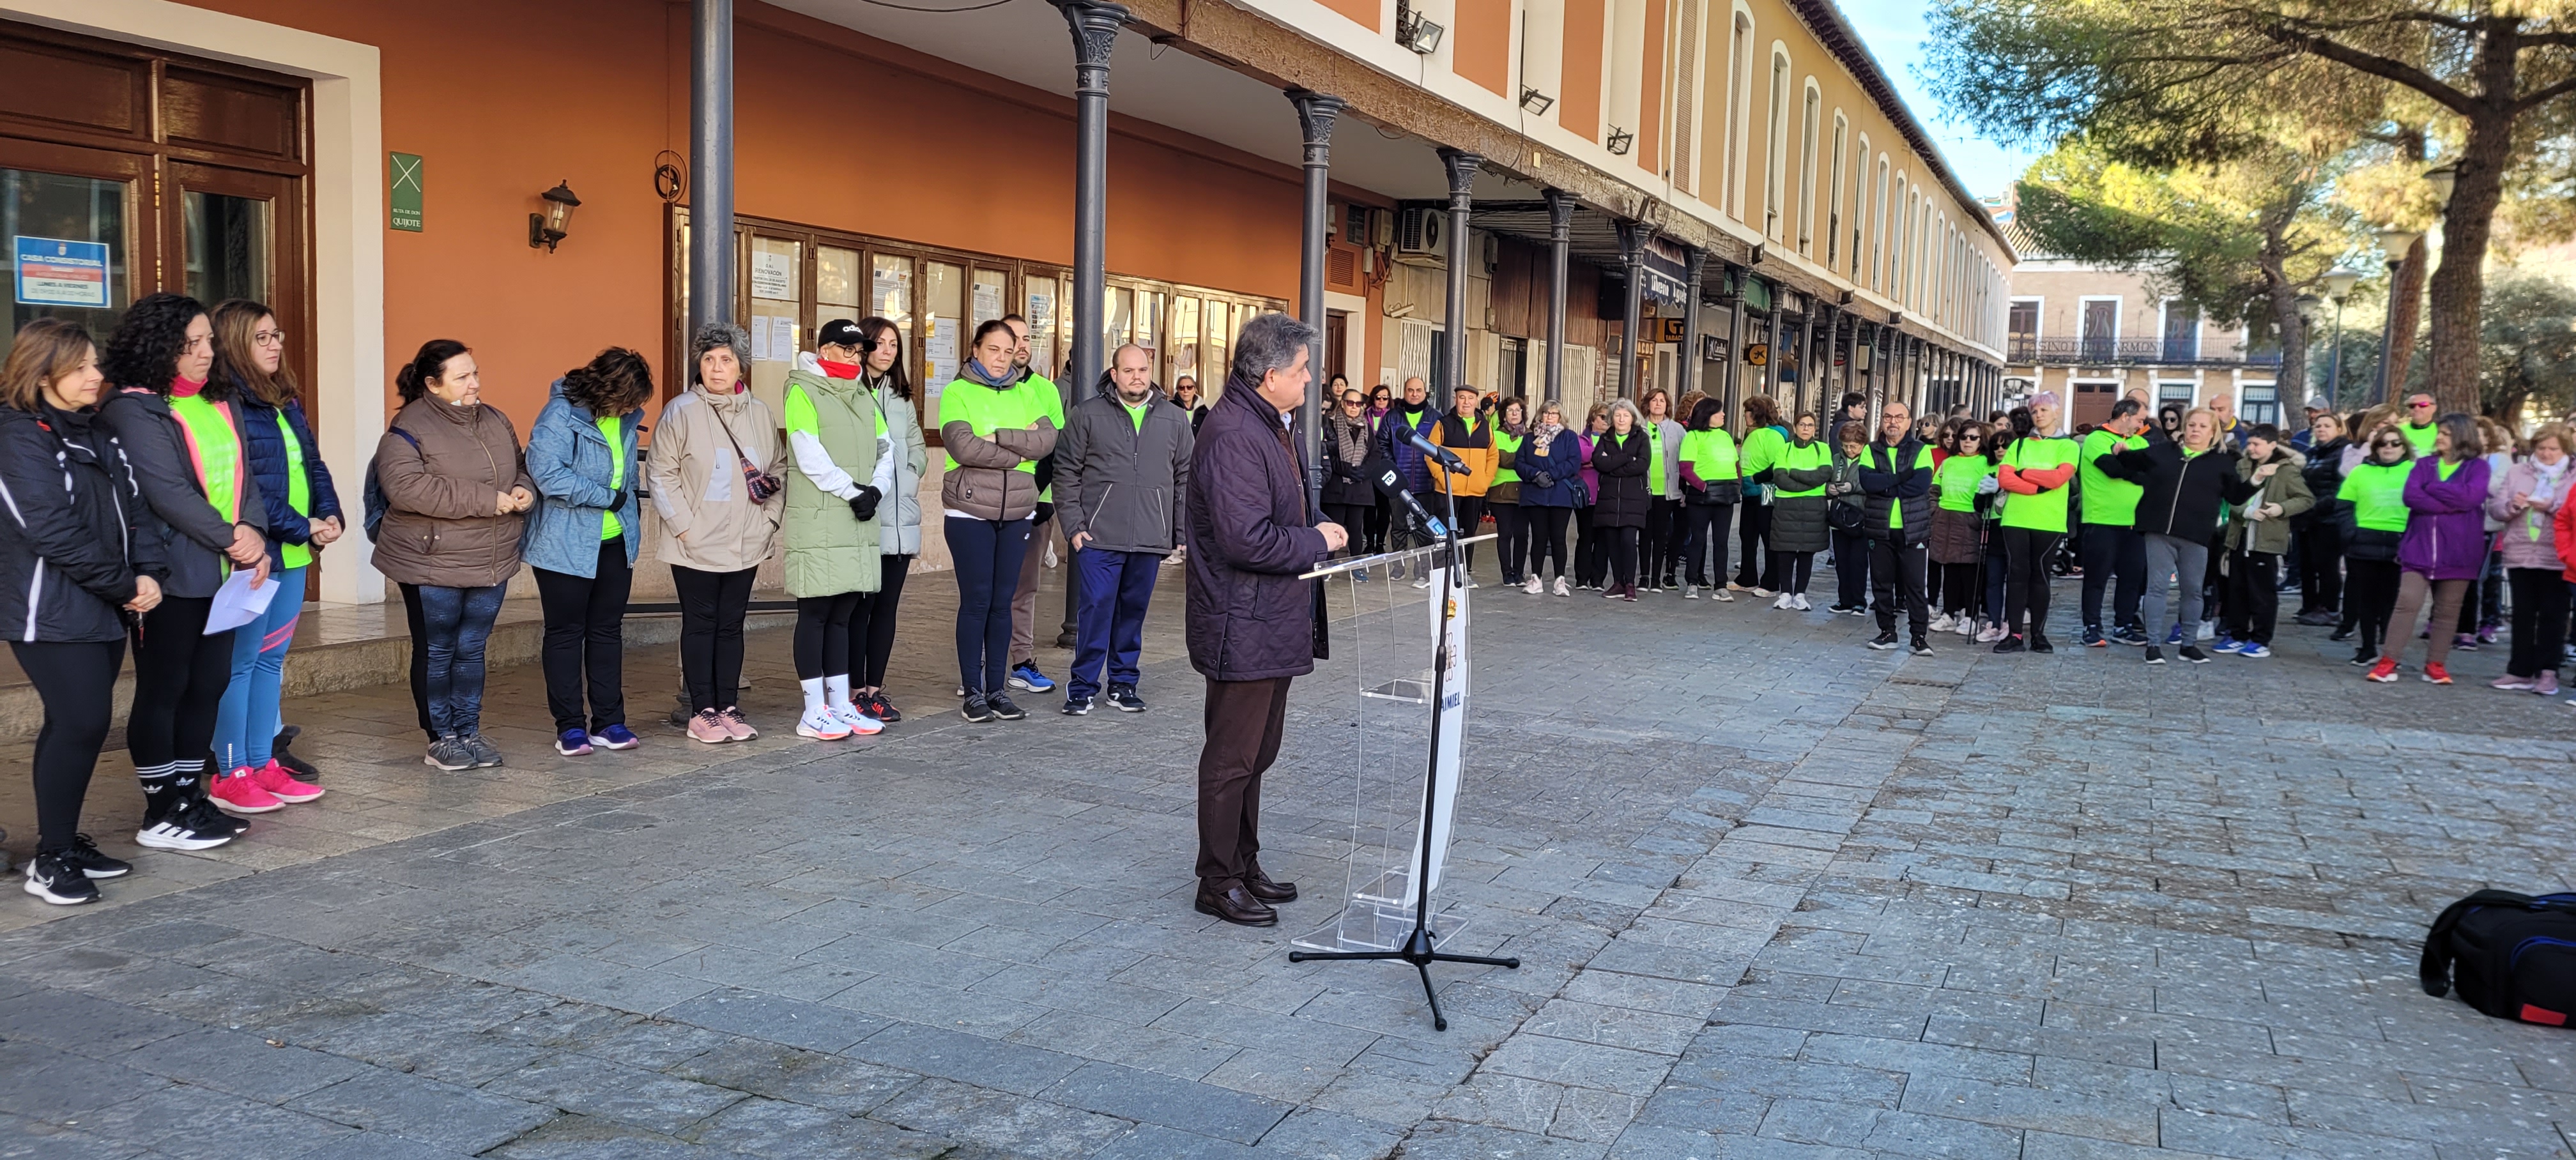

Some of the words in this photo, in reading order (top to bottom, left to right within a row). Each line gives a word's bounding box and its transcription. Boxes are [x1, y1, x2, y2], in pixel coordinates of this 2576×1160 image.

[392, 217, 421, 227] QUIJOTE
[20, 254, 45, 262] CASA
[755, 268, 783, 277] RENOVACIÓN
[842, 324, 863, 335] adid
[1637, 341, 1653, 355] ACOS
[2113, 342, 2164, 353] ARMONI
[1441, 691, 1460, 712] AIMIEL
